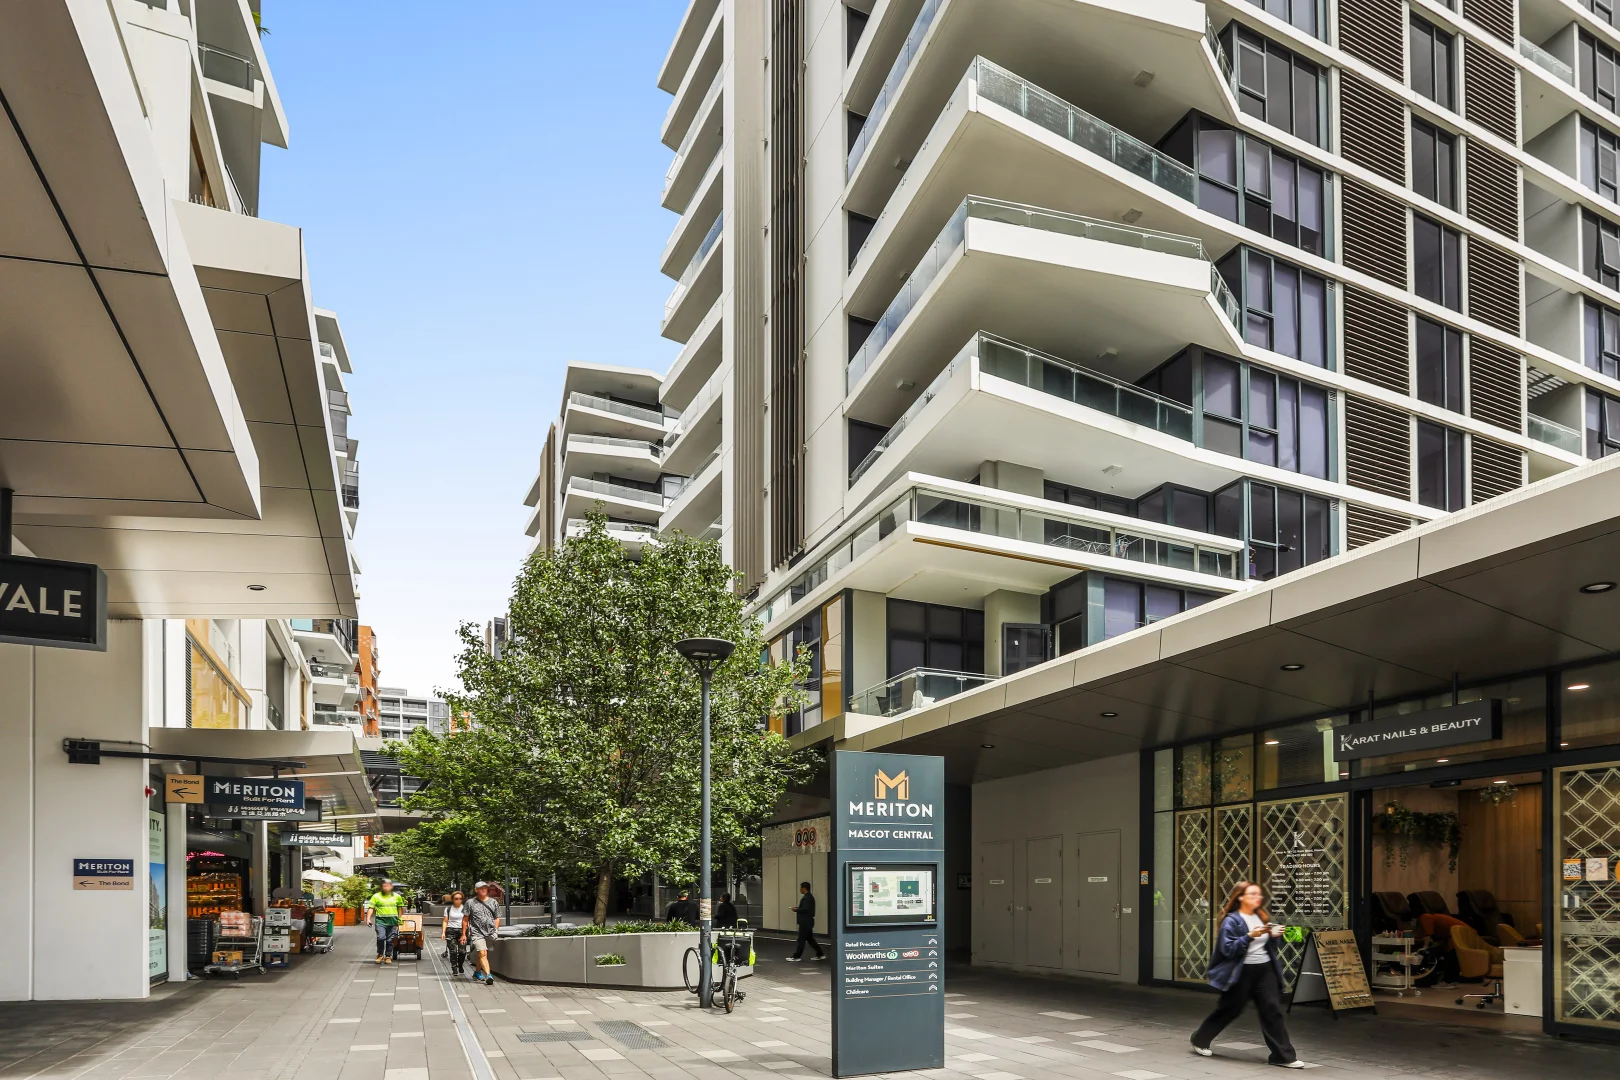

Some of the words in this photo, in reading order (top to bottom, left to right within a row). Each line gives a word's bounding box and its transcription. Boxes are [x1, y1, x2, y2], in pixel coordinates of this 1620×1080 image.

[1340, 733, 1380, 752] KARAT
[1383, 728, 1417, 741] NAILS
[1420, 726, 1428, 735] &
[1431, 717, 1482, 733] BEAUTY
[214, 781, 295, 797] MERITON
[849, 800, 933, 818] MERITON
[848, 829, 890, 839] MASCOT
[892, 830, 934, 840] CENTRAL
[78, 862, 130, 870] MERITON
[845, 951, 887, 960] Woolworths
